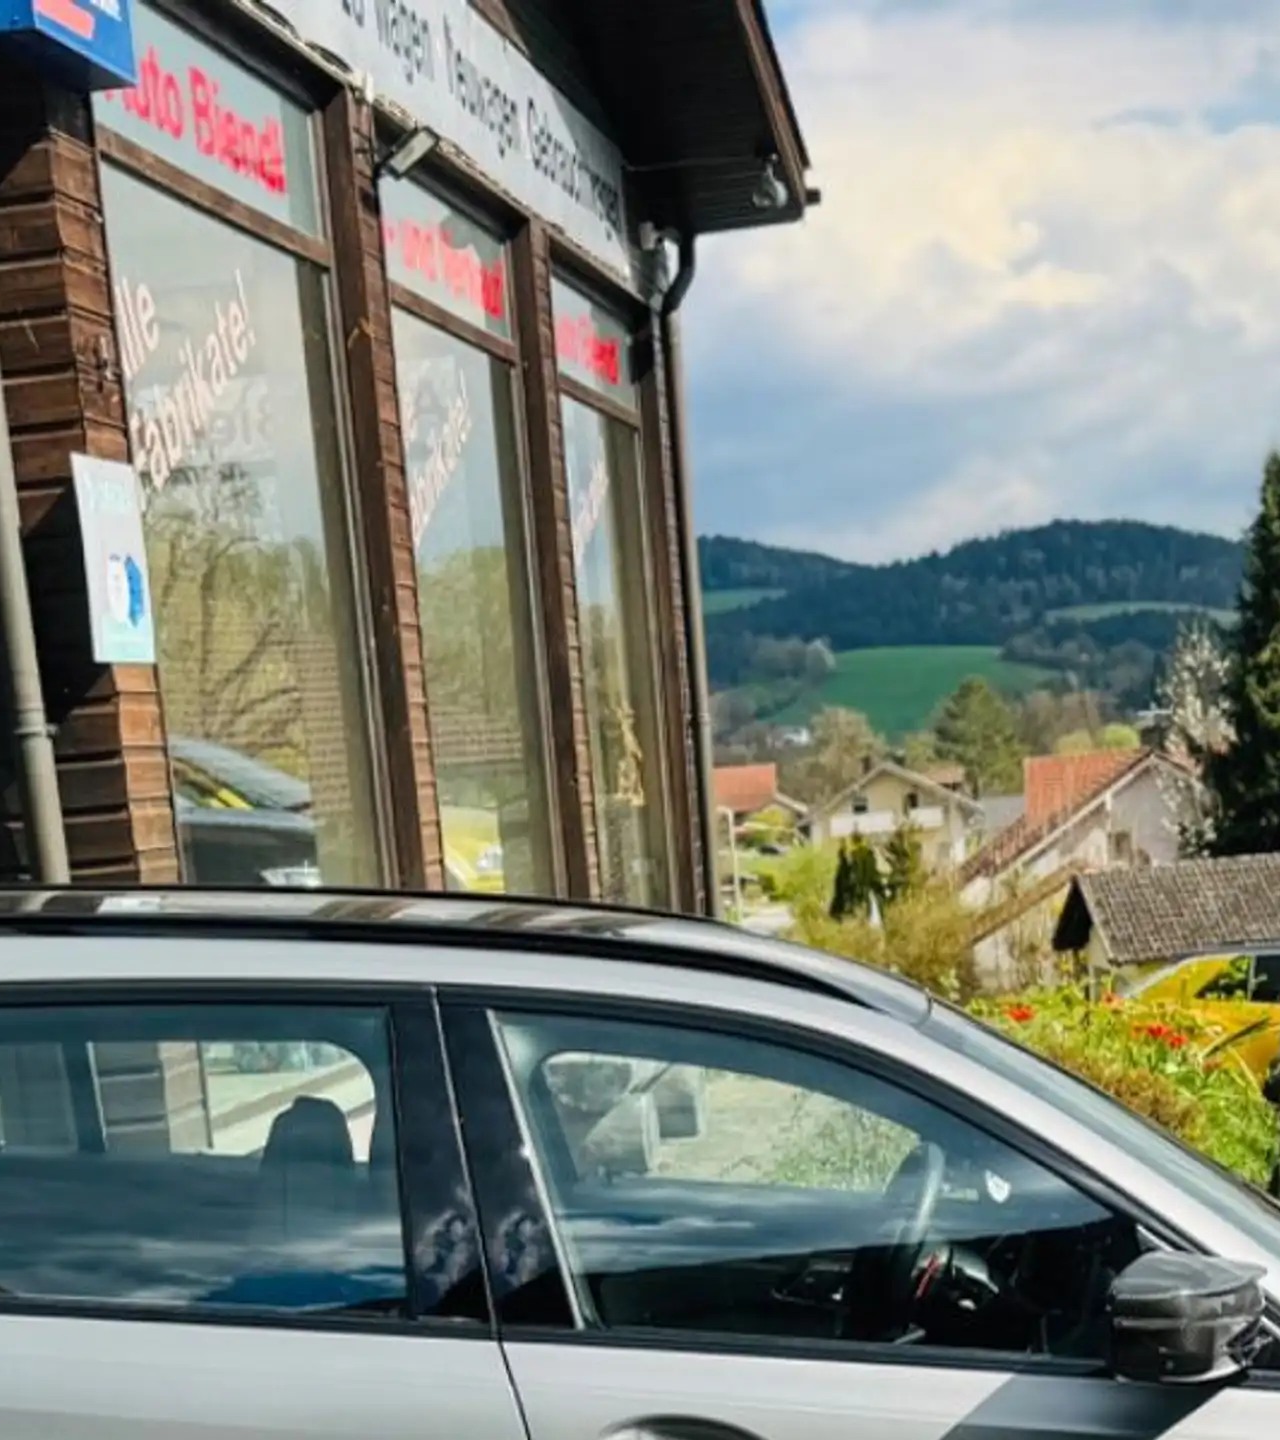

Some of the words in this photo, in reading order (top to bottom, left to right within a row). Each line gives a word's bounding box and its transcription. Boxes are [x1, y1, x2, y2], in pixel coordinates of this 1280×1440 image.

[105, 43, 184, 140] uto
[188, 64, 287, 193] Biendl
[115, 275, 160, 379] lle
